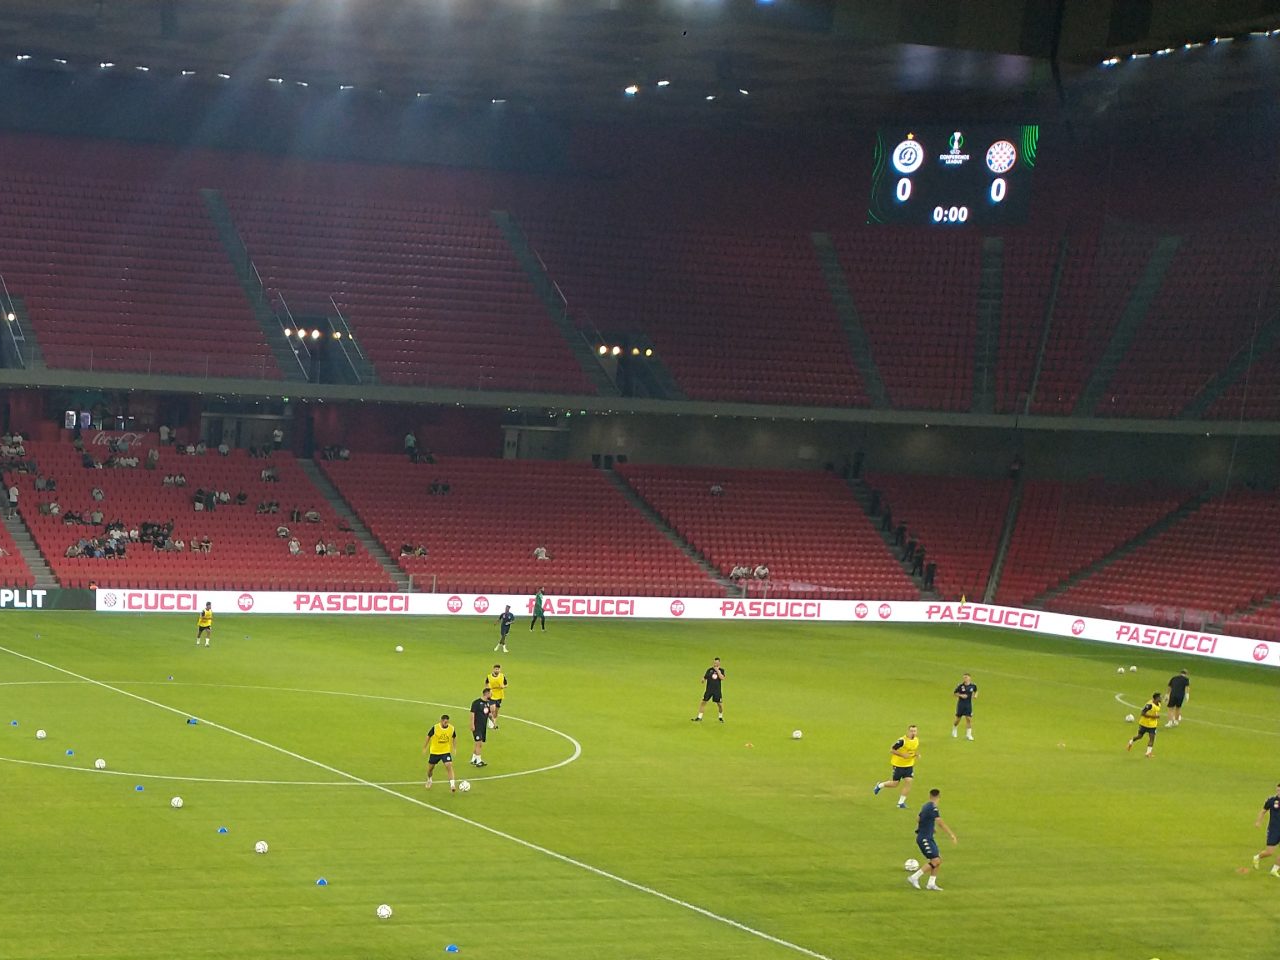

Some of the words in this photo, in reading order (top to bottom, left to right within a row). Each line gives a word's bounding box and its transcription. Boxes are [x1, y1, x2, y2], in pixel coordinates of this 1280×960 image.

[896, 178, 912, 201] 0
[990, 178, 1006, 202] 0
[933, 206, 969, 222] 0:00
[123, 592, 197, 611] CUCCI
[293, 594, 409, 612] PASCUCCI
[720, 601, 821, 617] PASCUCCI
[925, 600, 1041, 629] PASCUCCI
[1116, 624, 1218, 654] PASCUCCI
